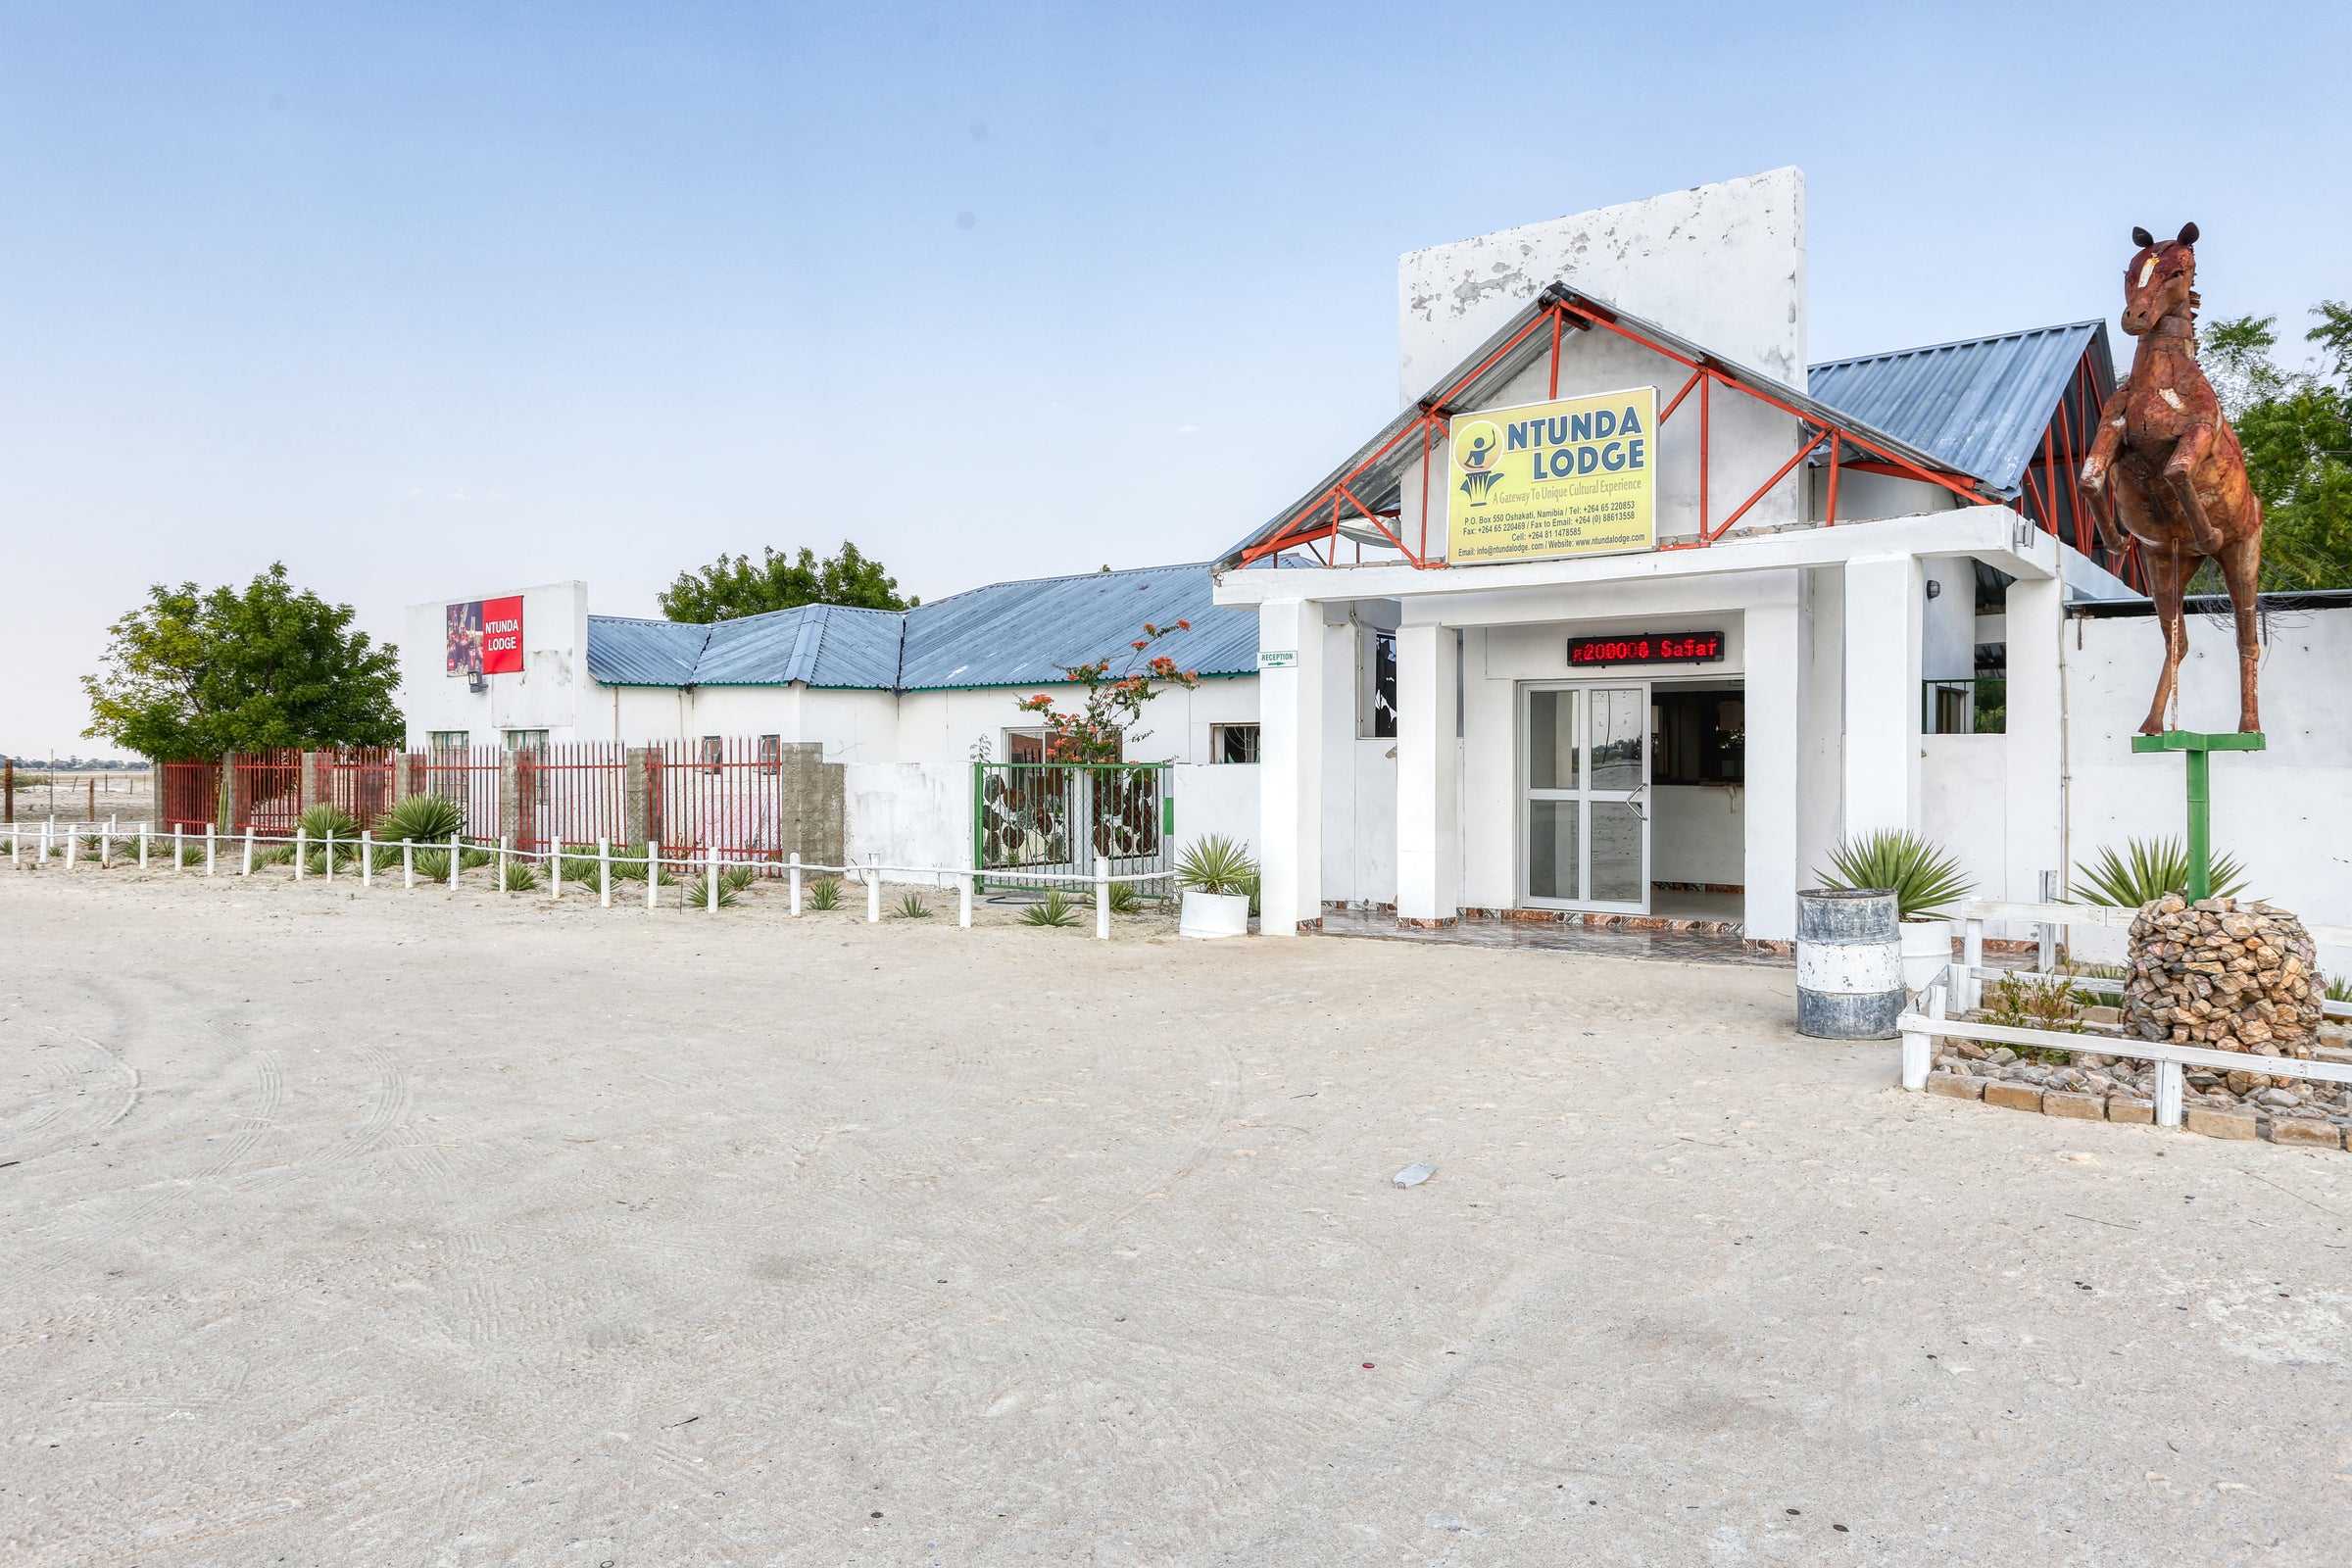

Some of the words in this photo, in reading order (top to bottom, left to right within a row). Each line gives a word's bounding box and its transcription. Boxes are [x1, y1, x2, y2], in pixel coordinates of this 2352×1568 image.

[1507, 406, 1642, 451] NTUNDA
[1534, 439, 1644, 480] LODGE
[1493, 492, 1498, 505] A
[1499, 491, 1530, 507] Gateway
[1531, 488, 1541, 501] To
[1542, 486, 1568, 502] Unique
[1569, 480, 1598, 496] Cultural
[1600, 478, 1642, 497] Experience
[1462, 527, 1476, 536] Fax:
[1478, 525, 1493, 534] +264
[1503, 521, 1526, 532] 220469
[1530, 520, 1542, 529] Fax
[1552, 517, 1573, 527] Email:
[1574, 515, 1591, 524] +264
[1592, 514, 1601, 525] (0)
[1602, 511, 1636, 522] 88613558
[1464, 516, 1477, 525] P.O.
[1479, 515, 1491, 524] Box
[1493, 514, 1504, 522] 550
[1505, 511, 1536, 521] Oshakati,
[1537, 509, 1564, 518] Namibia
[1569, 506, 1582, 515] Tel:
[1583, 505, 1599, 514] +264
[1600, 503, 1609, 512] 65
[1610, 500, 1636, 511] 220853
[1458, 548, 1475, 557] Email:
[1548, 539, 1574, 549] Website:
[1575, 533, 1645, 547] www.ntundalodge.com
[1511, 532, 1526, 542] Cell:
[1528, 531, 1544, 540] +264
[1554, 527, 1582, 537] 1478585
[485, 618, 519, 635] NTUNDA
[488, 636, 517, 652] LODGE
[1261, 653, 1294, 662] RECEPTION
